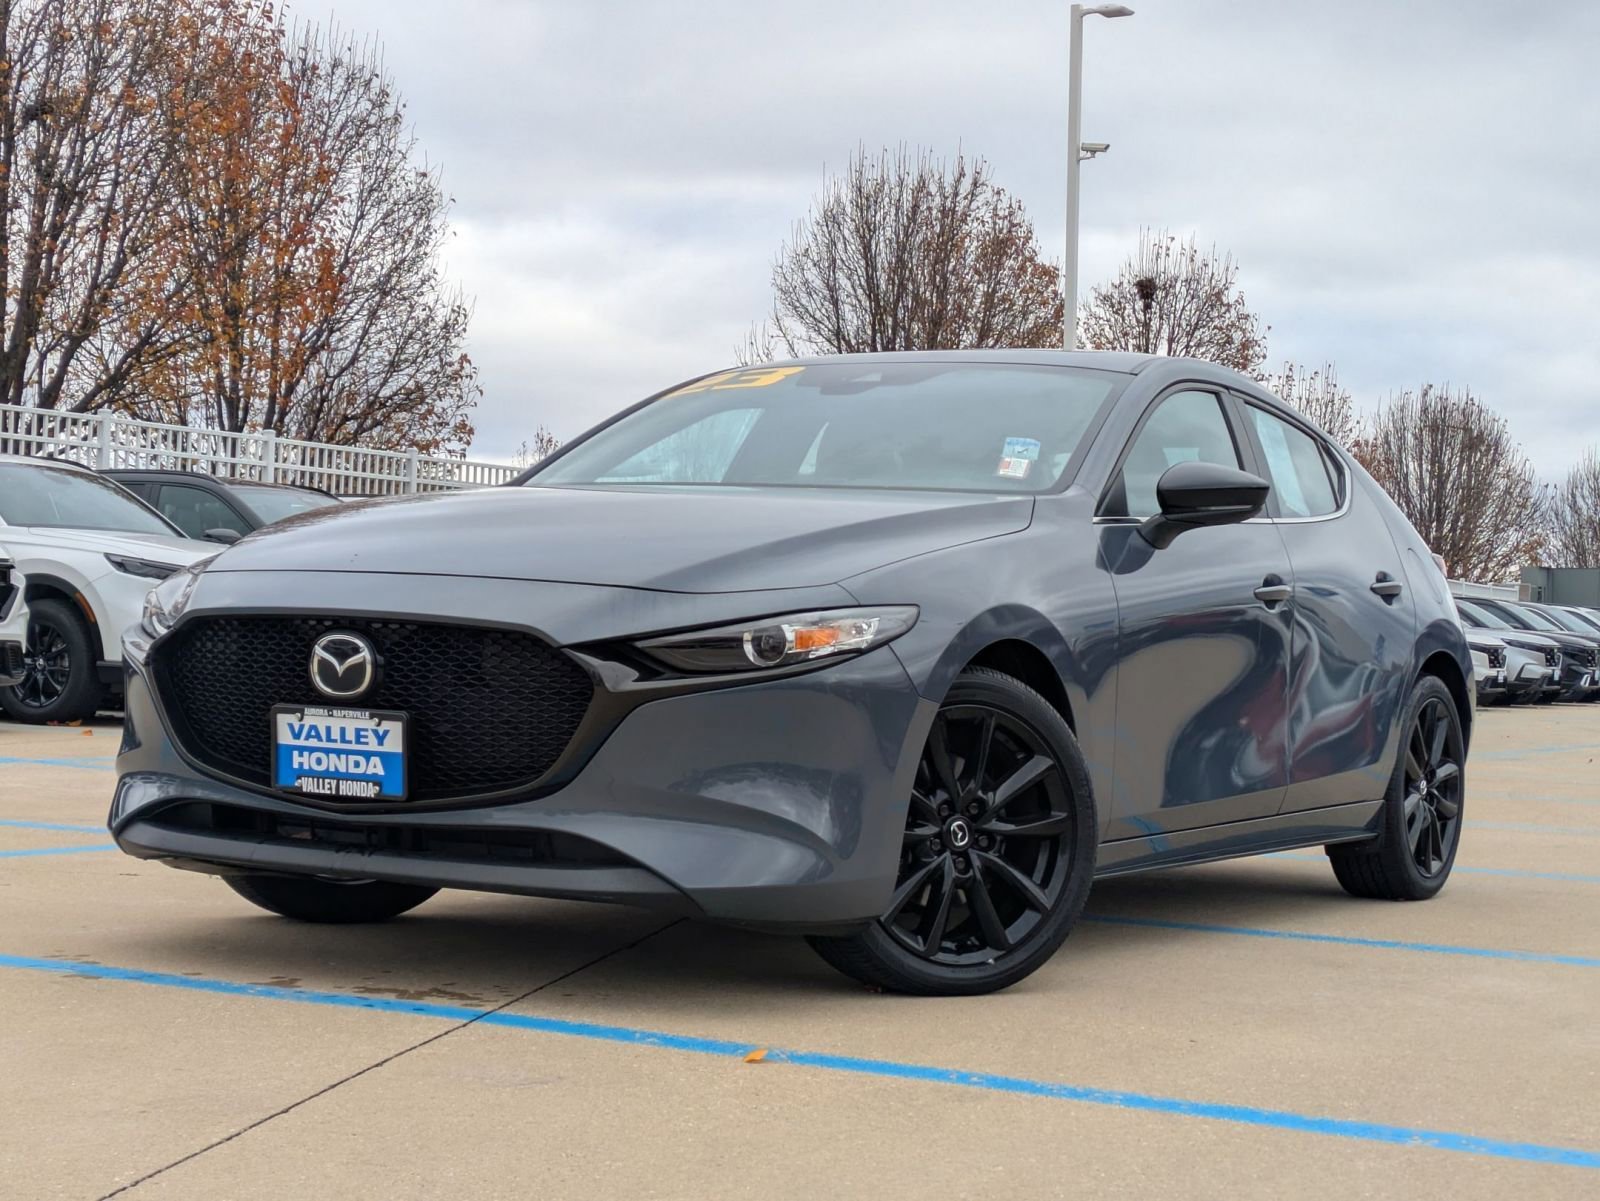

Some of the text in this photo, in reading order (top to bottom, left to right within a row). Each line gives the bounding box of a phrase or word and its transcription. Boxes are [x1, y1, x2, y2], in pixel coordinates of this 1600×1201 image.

[333, 709, 370, 719] NAPERVILLE
[287, 722, 391, 747] VALLEY
[292, 750, 385, 776] HONDA
[301, 776, 375, 798] VALLEY HONDA
